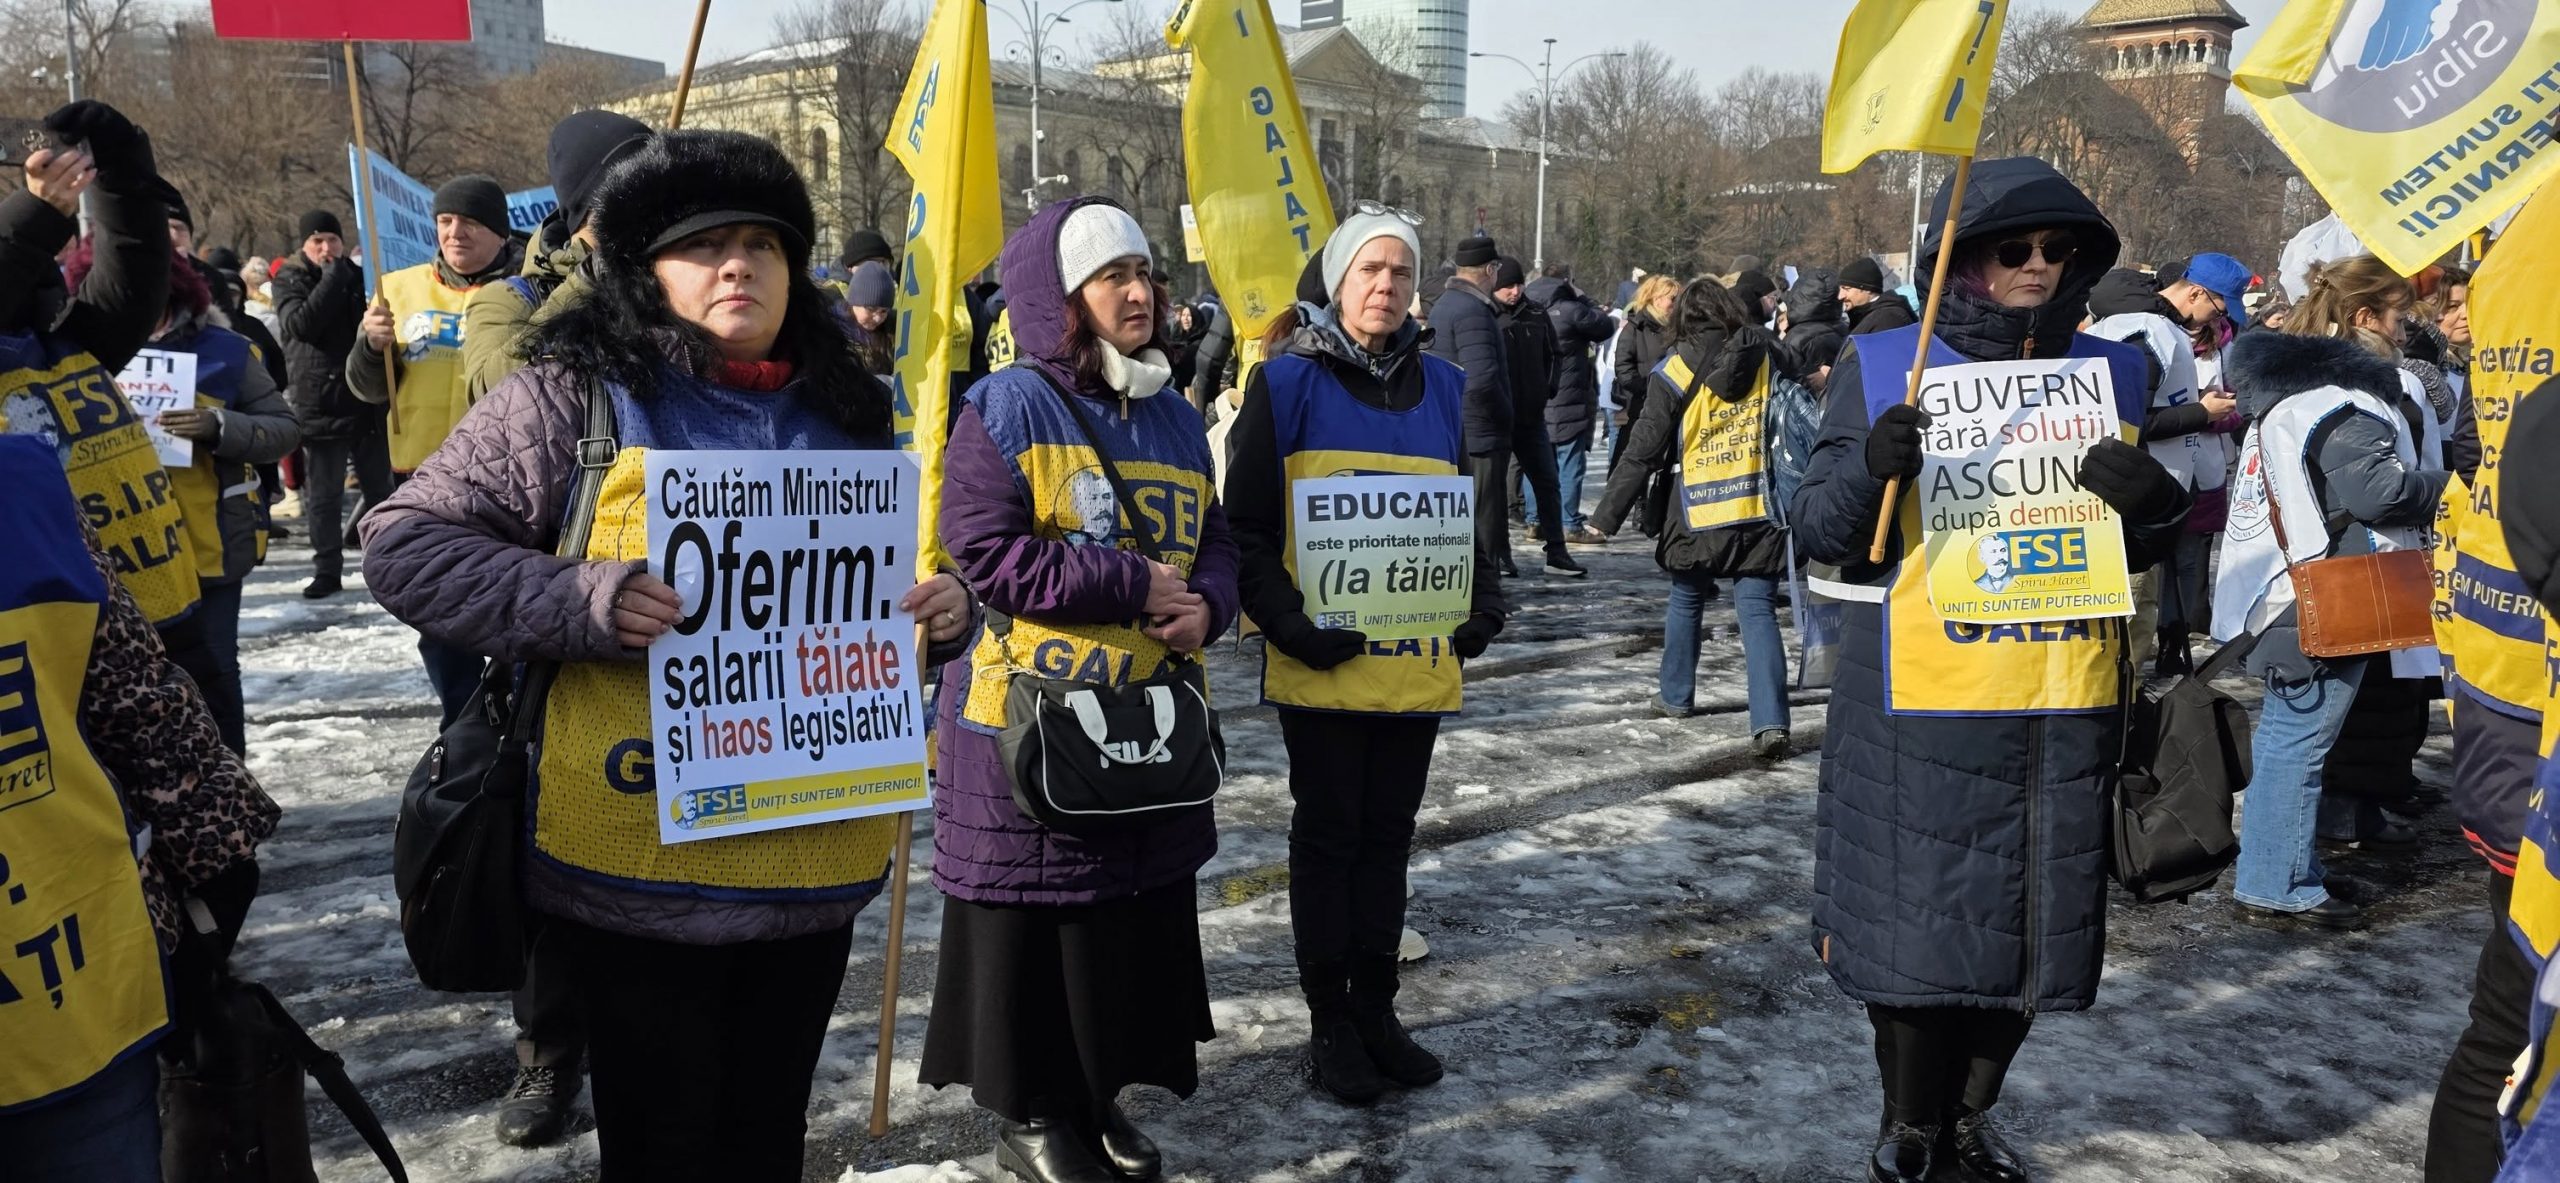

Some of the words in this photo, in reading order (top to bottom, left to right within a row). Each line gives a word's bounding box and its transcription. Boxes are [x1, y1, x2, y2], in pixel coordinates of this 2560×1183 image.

[1919, 372, 2103, 417] GUVERN
[661, 467, 772, 519] Căutăm
[782, 466, 898, 517] Ministru!
[1930, 455, 2084, 503] ASCUN
[1307, 491, 1470, 528] EDUCAȚIA
[1931, 504, 2001, 536] după
[2009, 500, 2108, 528] demisii!
[1306, 536, 1344, 551] este
[1348, 534, 1420, 552] prioritate
[1423, 532, 1471, 550] națională!
[2007, 532, 2085, 570] FSE
[663, 520, 895, 637] Oferim:
[1318, 560, 1371, 606] (la
[1386, 556, 1470, 599] tăieri)
[2013, 575, 2047, 591] Spiru
[2049, 574, 2088, 588] Haret
[1942, 601, 1977, 617] UNIȚI
[1981, 598, 2041, 613] SUNTEM
[2045, 592, 2126, 609] PUTERNICI!
[2473, 580, 2546, 620] PUTERN
[1326, 612, 1356, 627] FSE
[1364, 614, 1393, 628] UNIȚI
[1395, 612, 1437, 624] SUNTEM
[663, 632, 786, 711] salarii
[796, 626, 901, 699] tăiate
[667, 711, 693, 783] și
[701, 709, 773, 760] haos
[780, 690, 914, 762] legislativ!
[1100, 740, 1172, 768] FILA
[696, 785, 746, 813] FSE
[751, 795, 787, 811] UNIȚI
[790, 786, 845, 804] SUNTEM
[849, 776, 921, 796] PUTERNICI!
